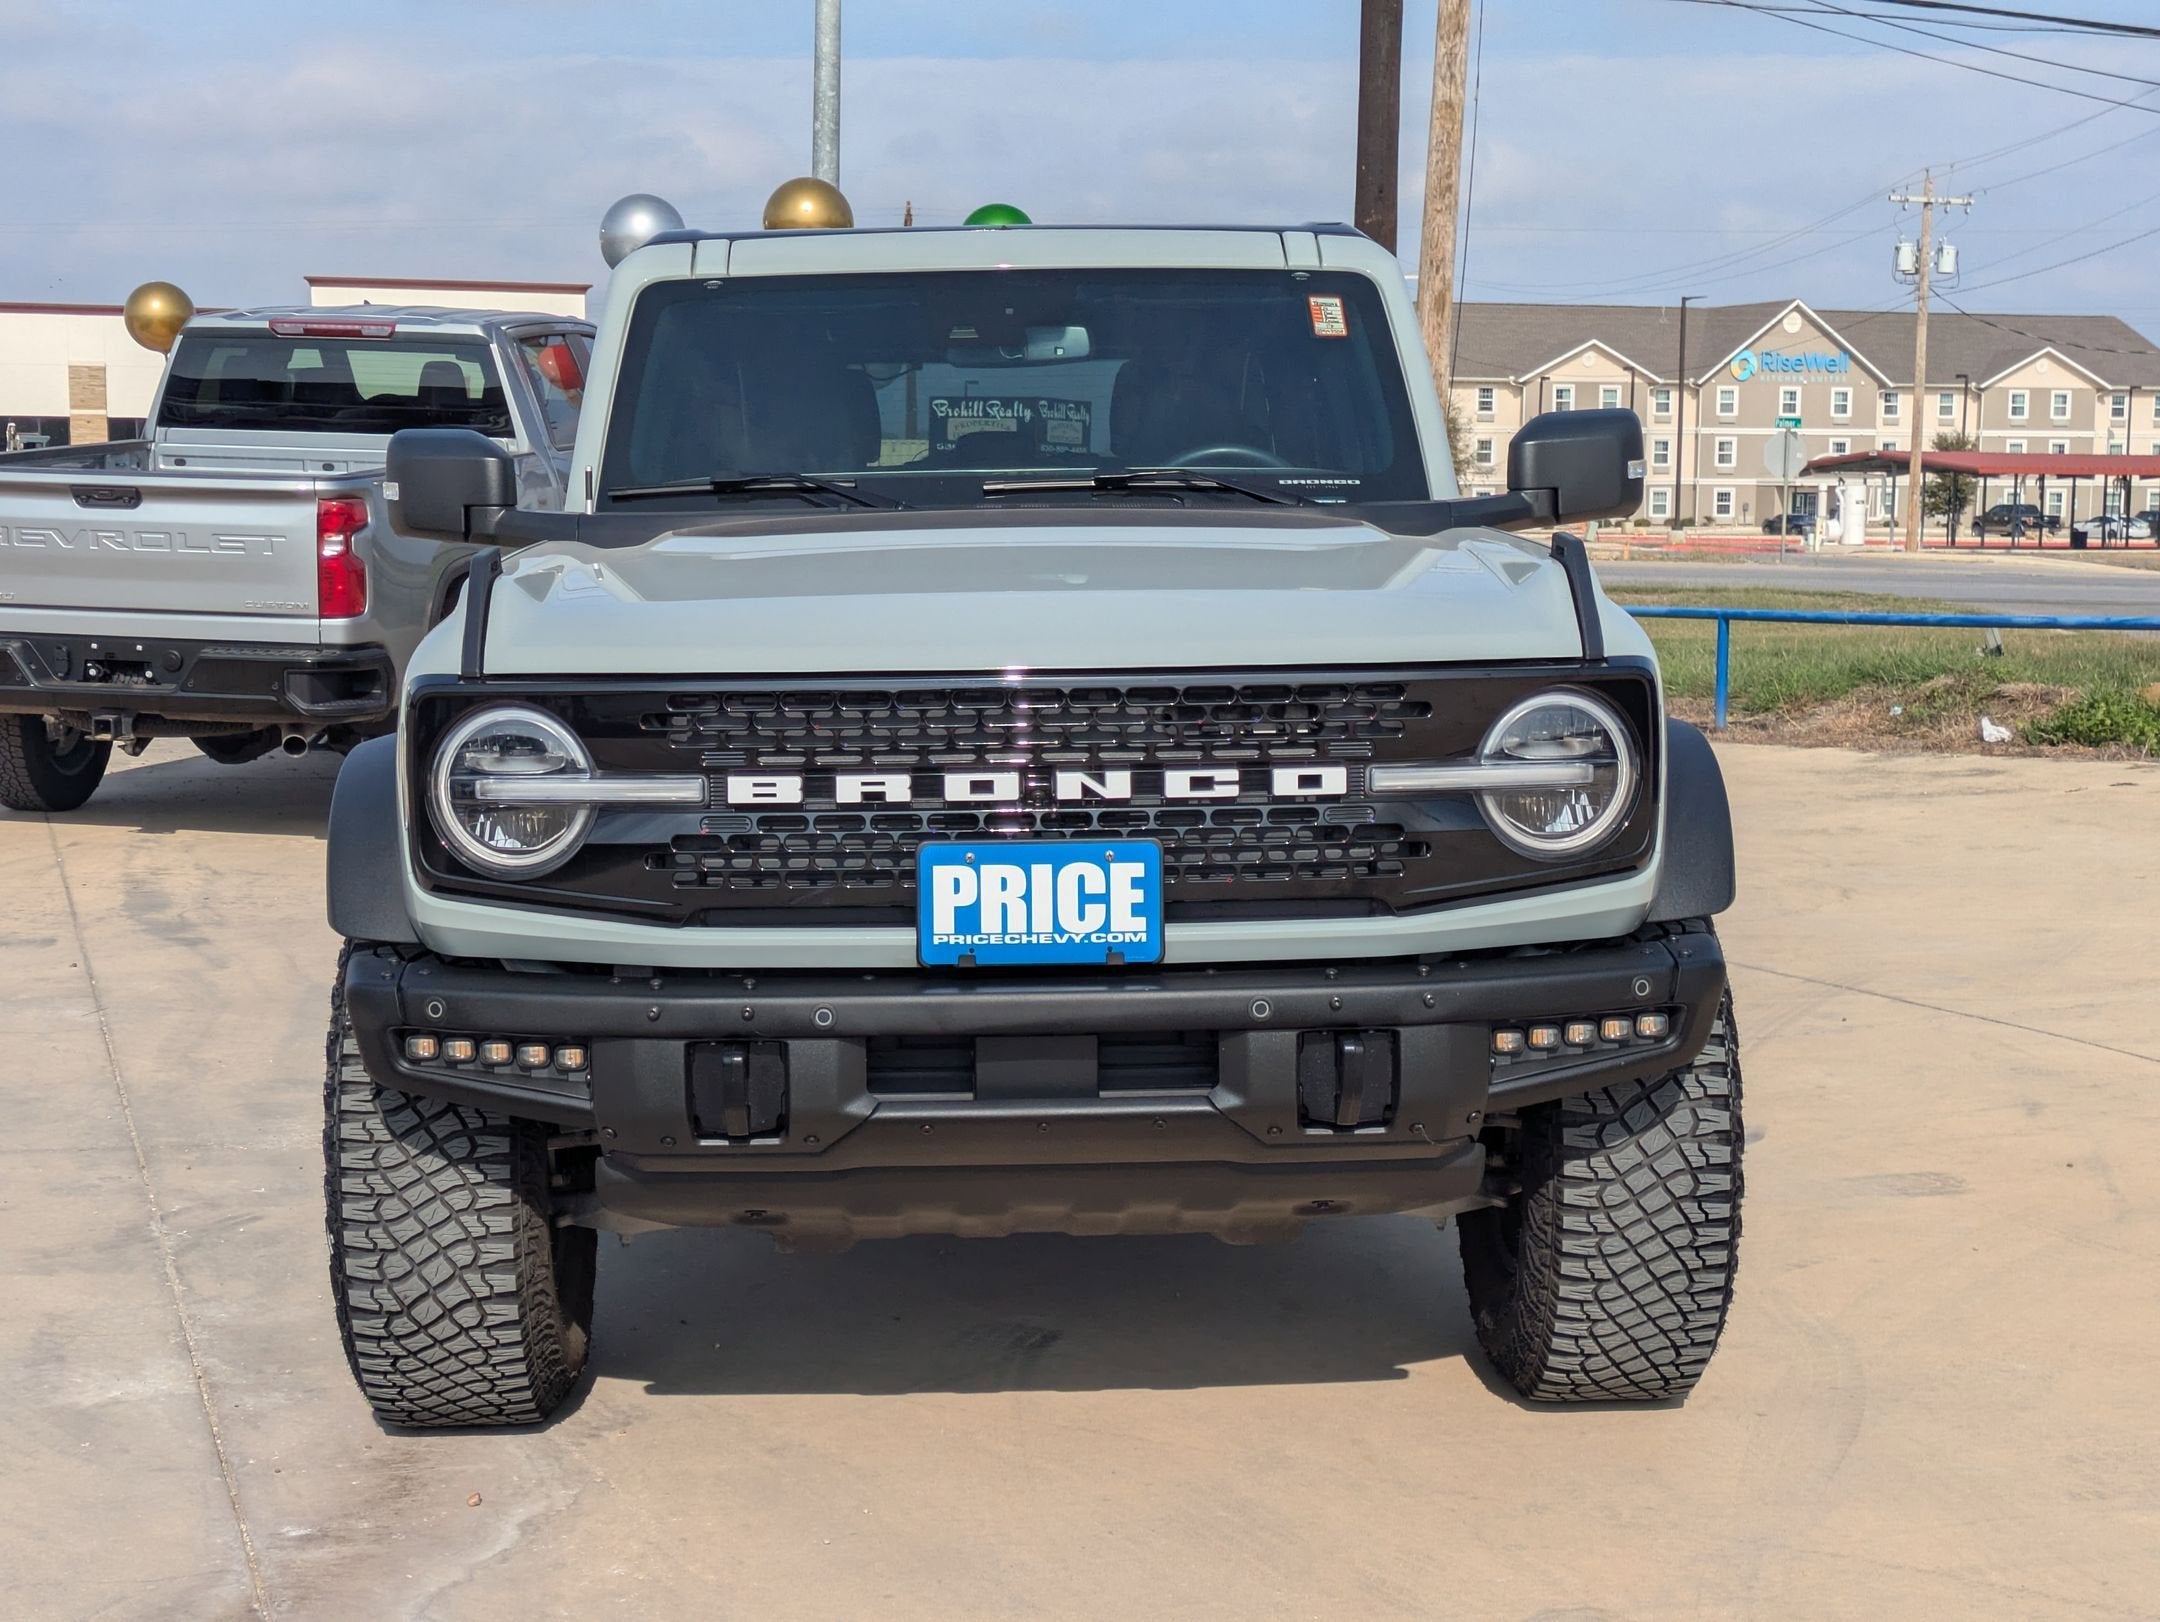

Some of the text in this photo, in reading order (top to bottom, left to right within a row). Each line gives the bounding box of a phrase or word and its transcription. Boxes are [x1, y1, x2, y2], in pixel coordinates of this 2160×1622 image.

[1760, 351, 1849, 373] RiseWell
[244, 600, 310, 610] CUSTOM
[726, 766, 1348, 804] BRONCO
[932, 862, 1147, 934] PRICE
[933, 932, 1147, 945] PRICECHEVY.COM
